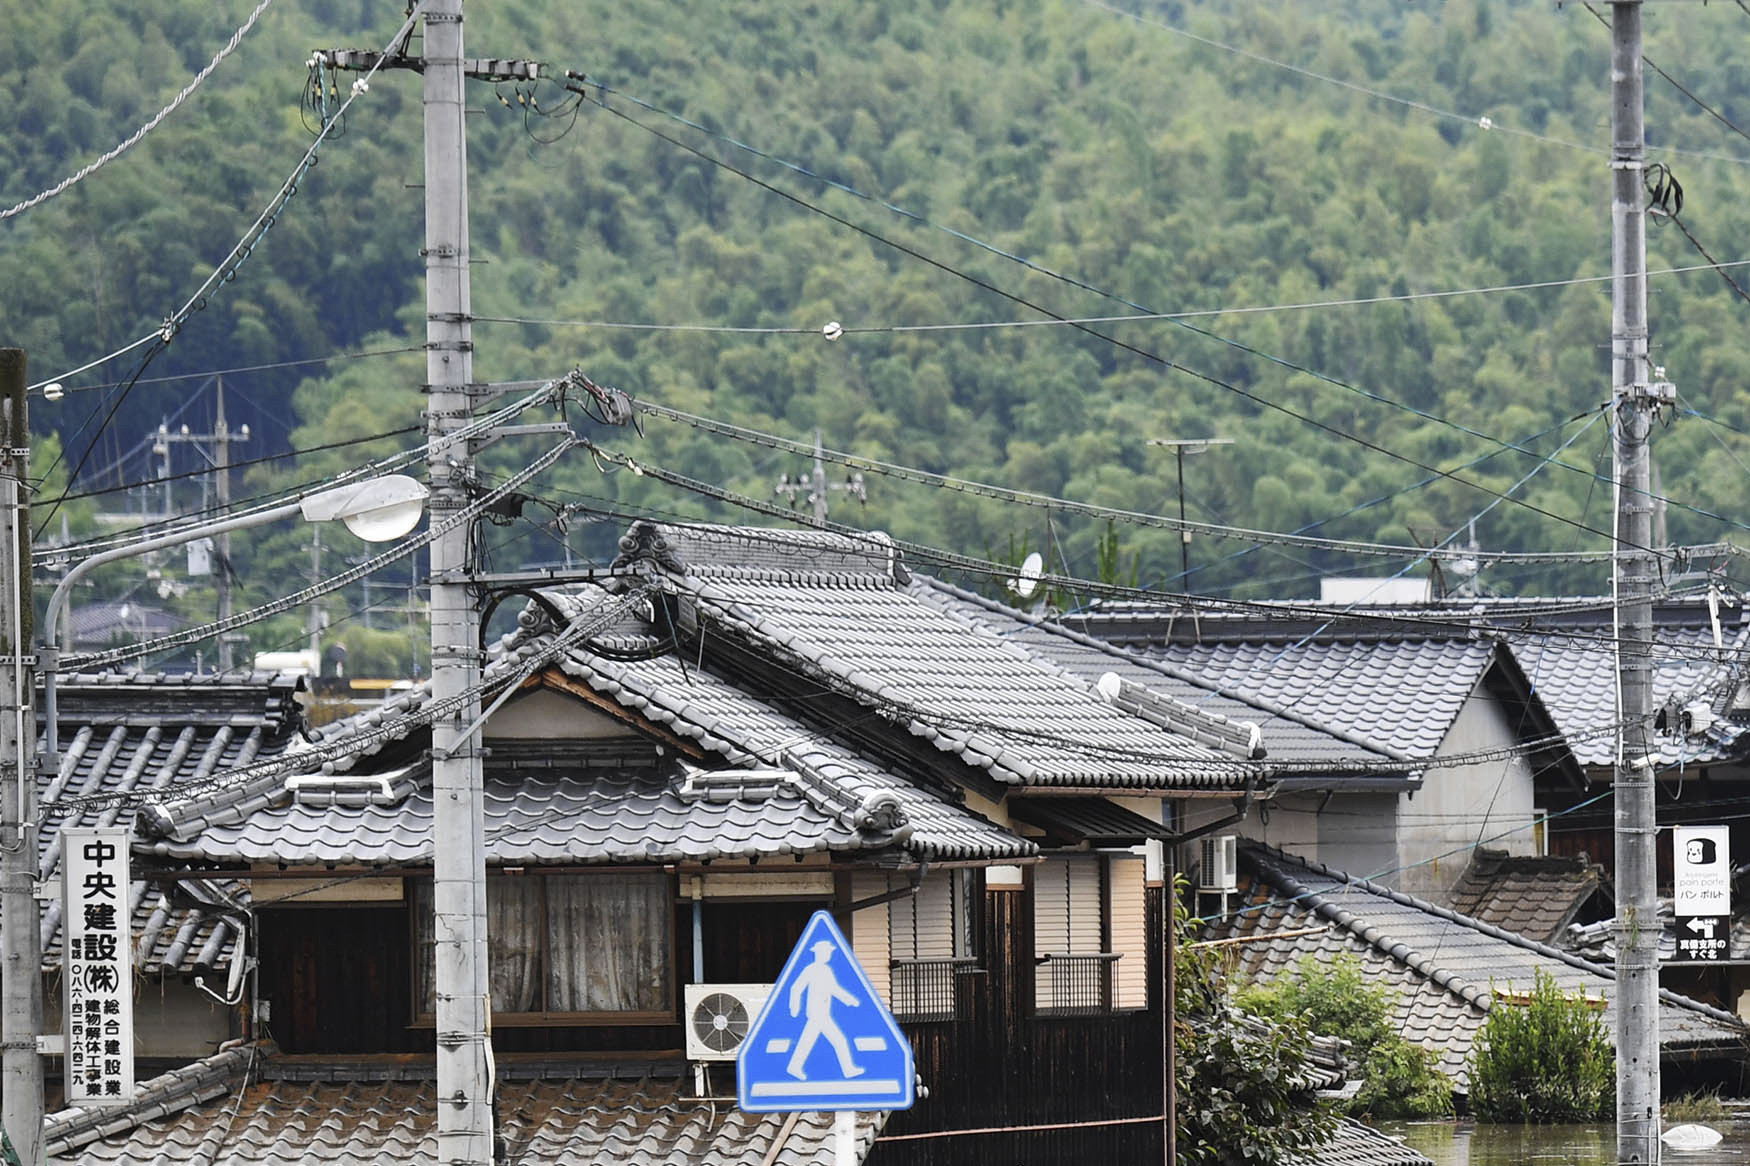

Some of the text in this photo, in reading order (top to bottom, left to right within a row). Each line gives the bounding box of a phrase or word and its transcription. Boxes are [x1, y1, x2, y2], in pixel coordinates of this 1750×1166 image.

[103, 999, 121, 1096] 総合建設業
